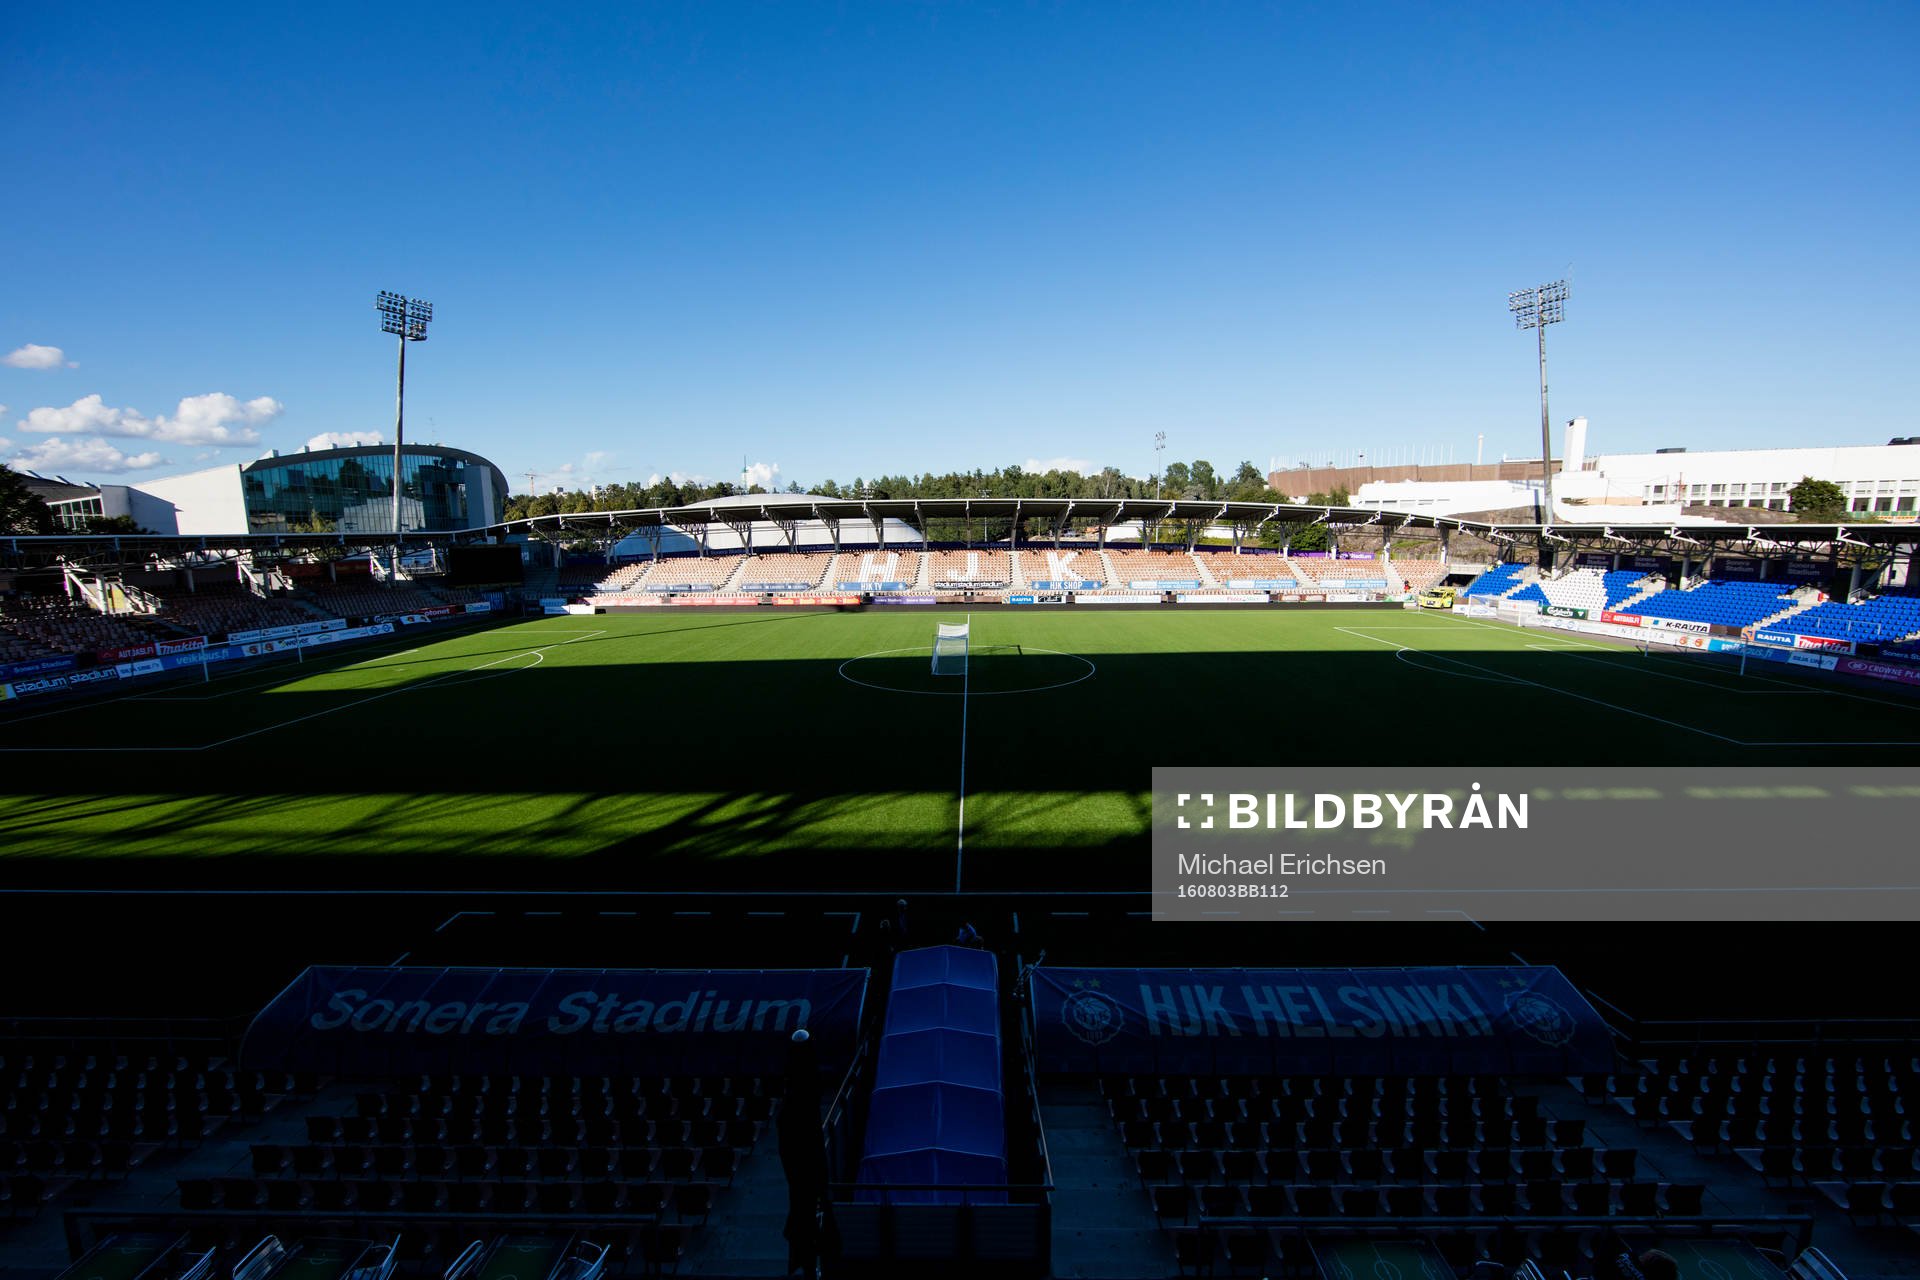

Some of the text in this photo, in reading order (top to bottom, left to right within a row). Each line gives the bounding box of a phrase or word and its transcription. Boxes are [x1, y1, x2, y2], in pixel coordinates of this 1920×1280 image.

[861, 582, 882, 590] HJK TV
[1050, 581, 1083, 590] HJK SHOP
[1665, 621, 1708, 633] K-RAUTA
[1756, 633, 1793, 643] RAUTIA
[14, 667, 118, 693] stadium stadium
[309, 989, 813, 1035] Sonera Stadium
[1138, 984, 1496, 1038] HJK HELSINKI
